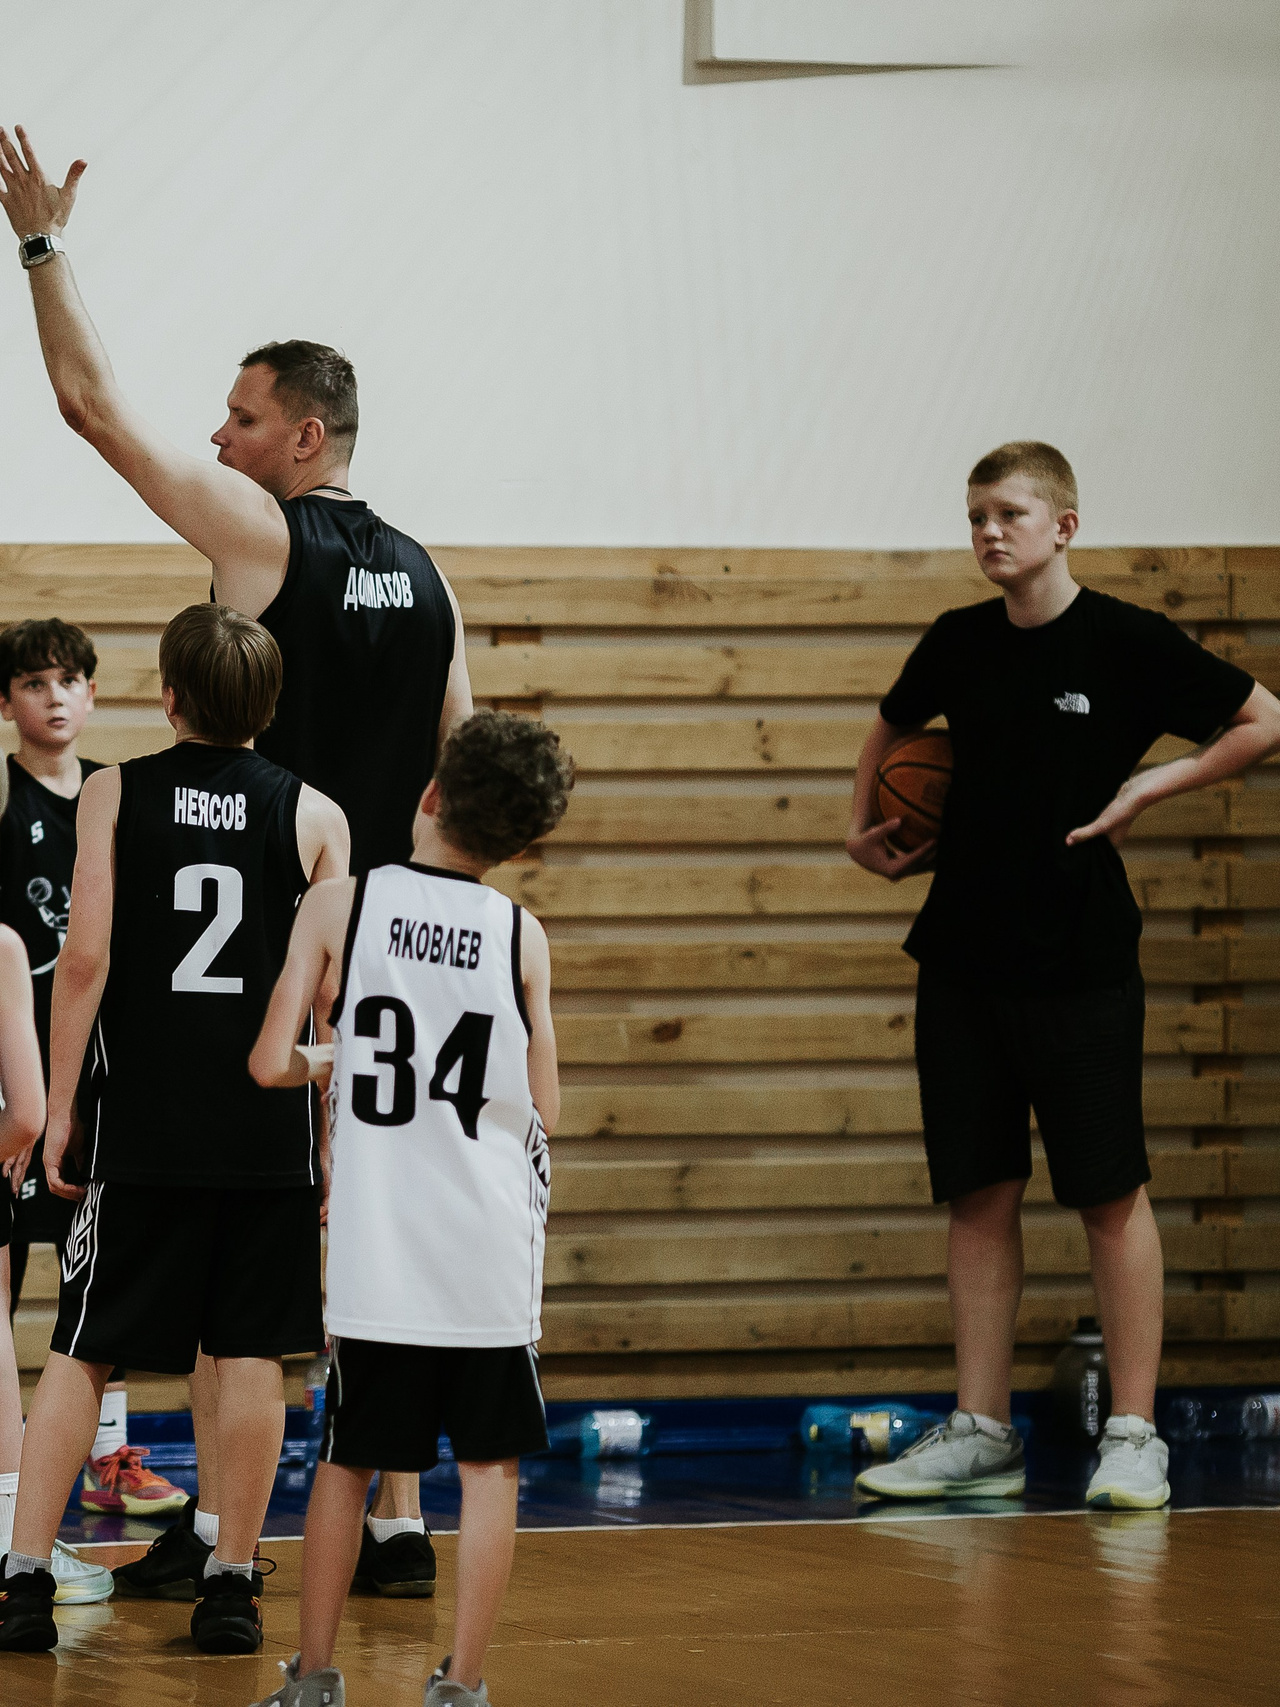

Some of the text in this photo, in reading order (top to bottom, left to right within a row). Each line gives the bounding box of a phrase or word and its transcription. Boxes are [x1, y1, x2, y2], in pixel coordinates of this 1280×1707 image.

[174, 786, 247, 831] НЕЯСОВ
[171, 863, 244, 994] 2
[387, 917, 482, 970] ЯКОВЛЕВ
[351, 995, 494, 1141] 34
